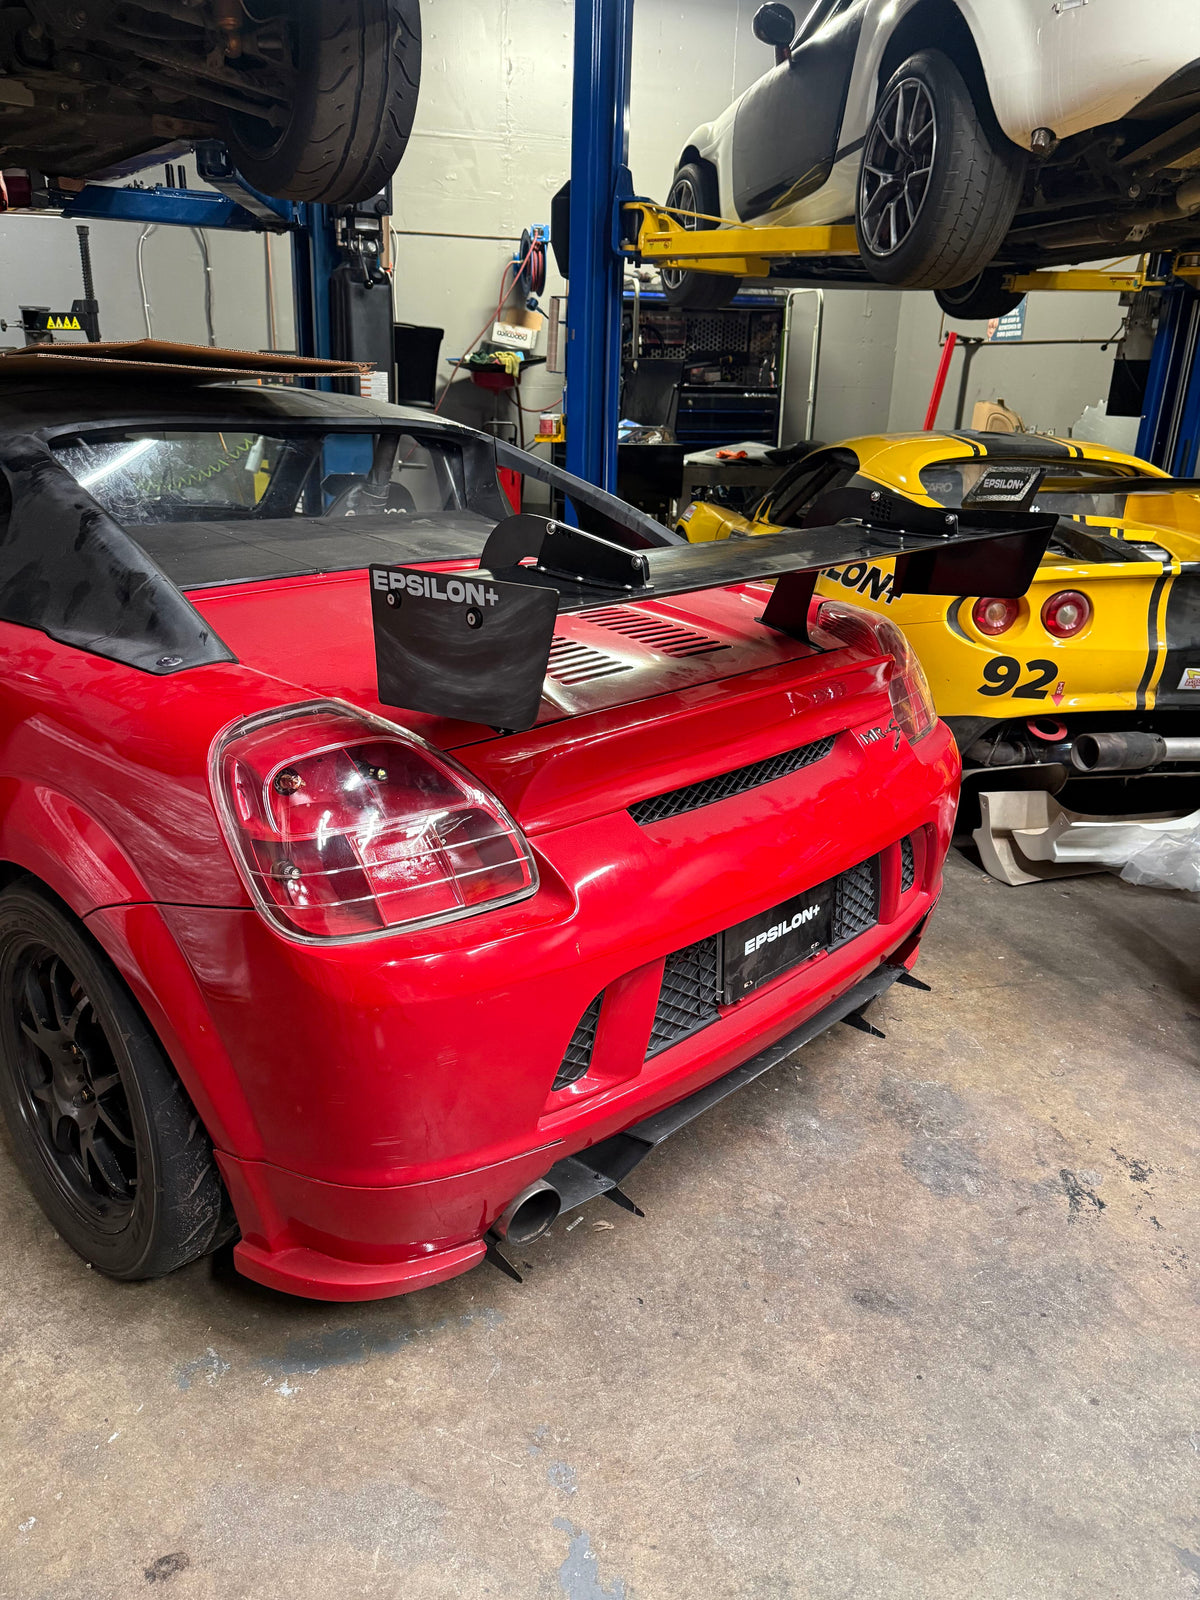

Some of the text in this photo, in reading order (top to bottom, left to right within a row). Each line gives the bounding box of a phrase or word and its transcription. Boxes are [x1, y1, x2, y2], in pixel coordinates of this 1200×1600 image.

[983, 478, 1024, 489] EPSILON+
[372, 569, 499, 607] EPSILON+
[976, 655, 1059, 700] 92
[858, 718, 901, 751] MR-S
[744, 904, 821, 957] EPSILON+
